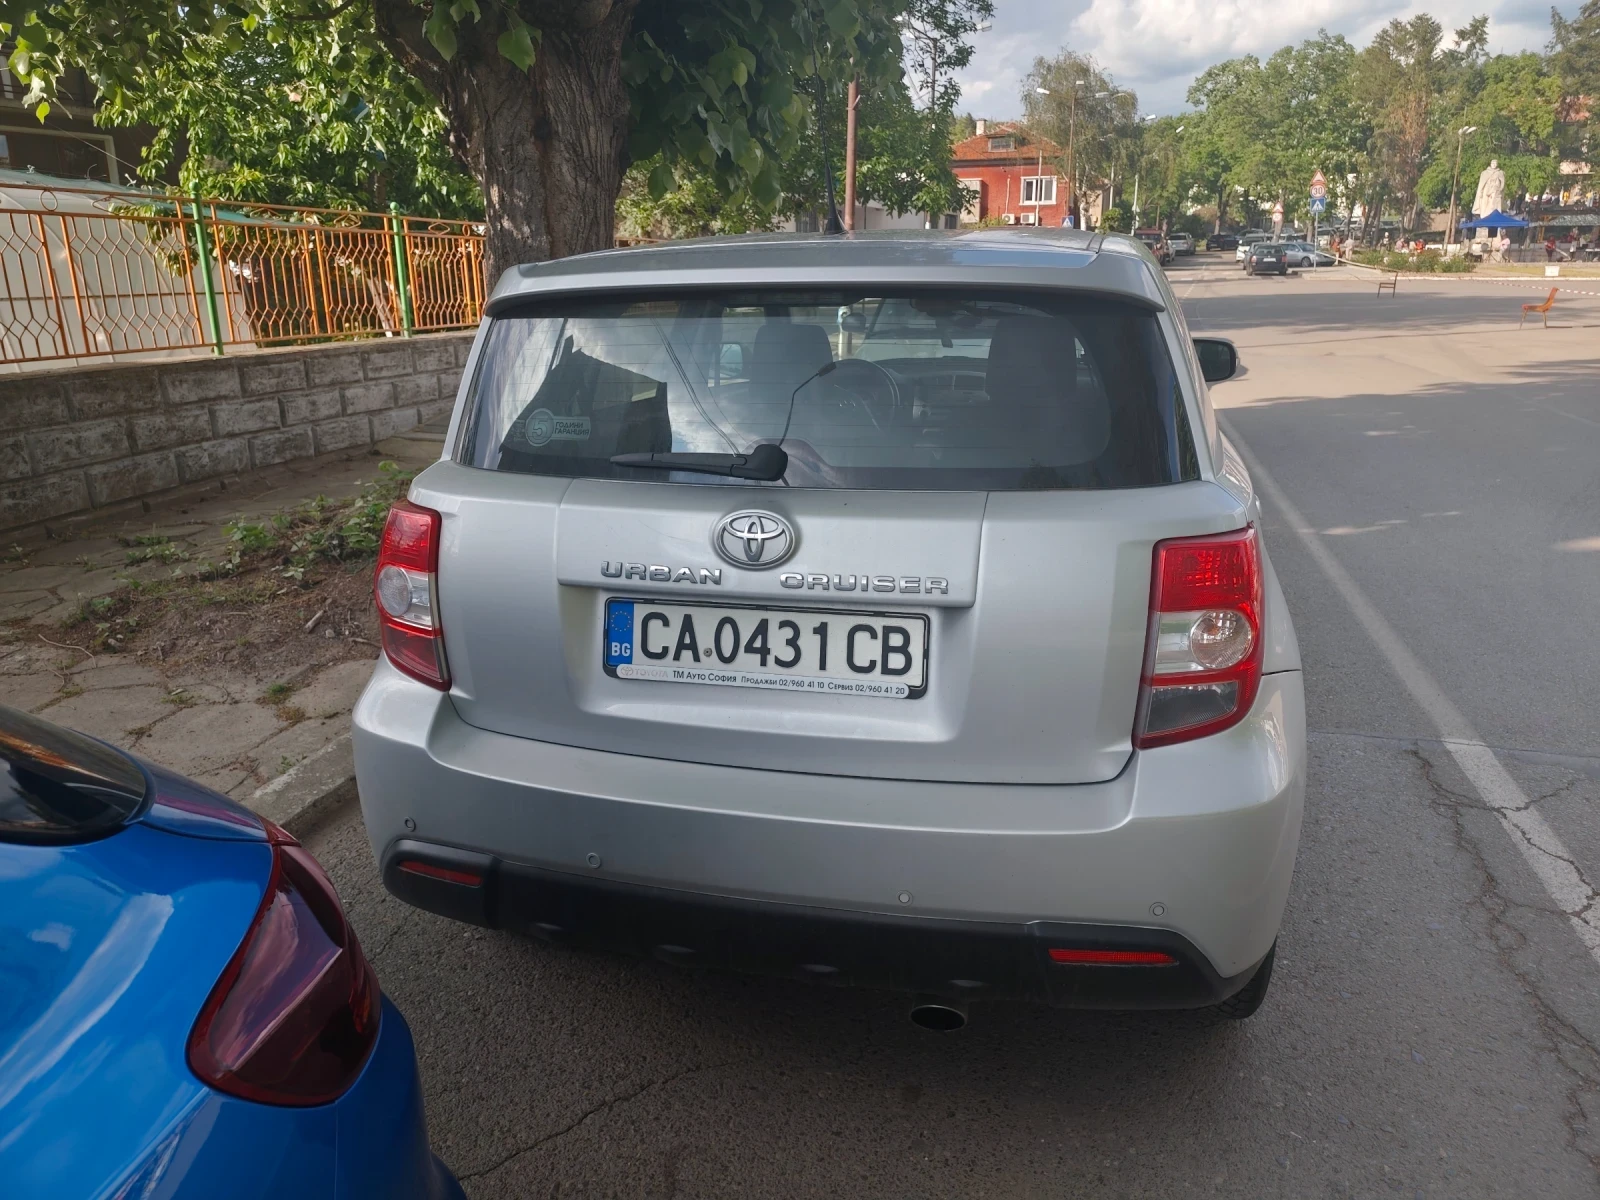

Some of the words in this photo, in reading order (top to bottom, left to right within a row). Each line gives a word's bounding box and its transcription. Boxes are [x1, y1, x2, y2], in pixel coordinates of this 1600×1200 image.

[1313, 187, 1322, 195] 30
[532, 418, 548, 439] 5
[555, 421, 584, 429] ГОДИНИ
[554, 428, 590, 436] ГАРАНЦИЯ
[600, 560, 722, 586] URBAN
[779, 572, 949, 595] CRUISER
[611, 642, 631, 657] BG
[634, 669, 668, 678] TOYOTA
[778, 678, 805, 688] 02/960
[806, 681, 815, 689] 41
[817, 681, 825, 689] 10
[855, 684, 882, 693] 02/960
[883, 686, 893, 694] 41
[895, 687, 905, 695] 20
